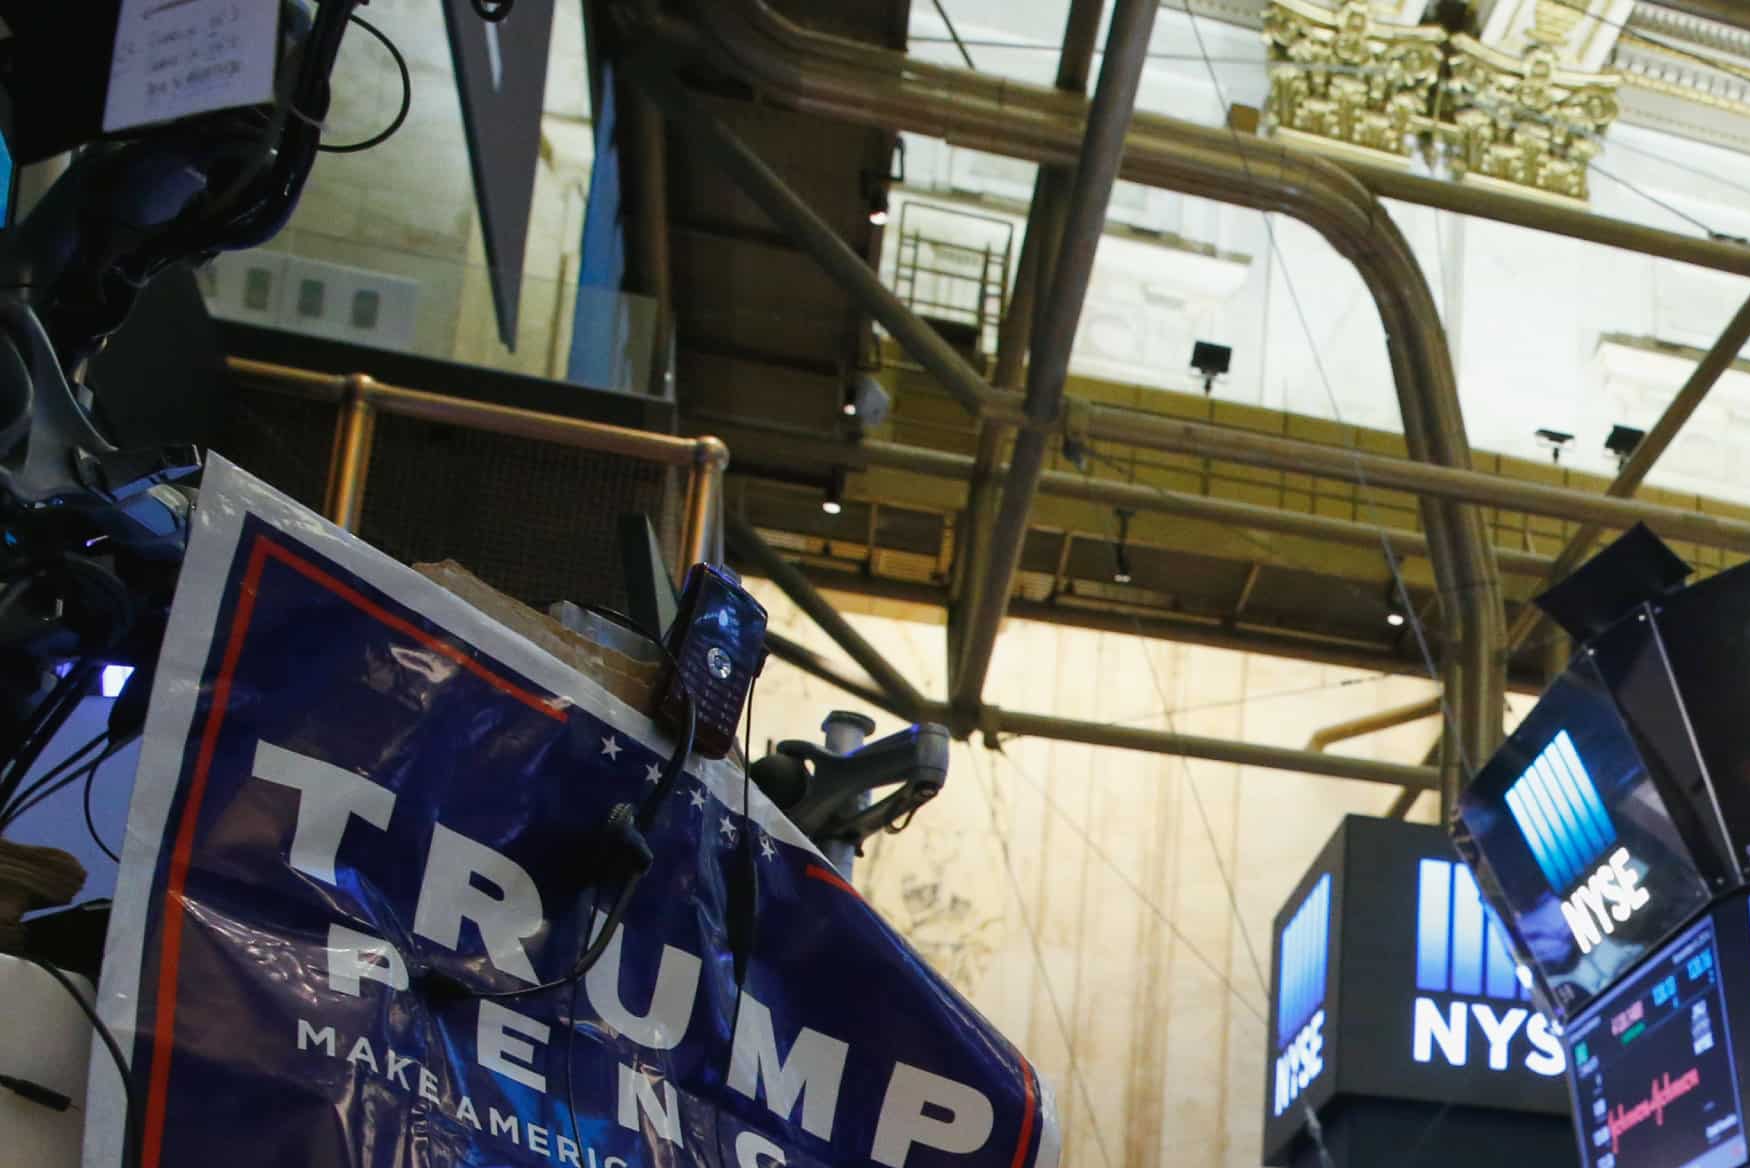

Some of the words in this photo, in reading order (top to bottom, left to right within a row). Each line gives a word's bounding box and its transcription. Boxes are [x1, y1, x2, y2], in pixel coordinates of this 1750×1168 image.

[1560, 846, 1651, 954] NYSE
[297, 1018, 441, 1106] MAKE
[1413, 997, 1567, 1077] NYS
